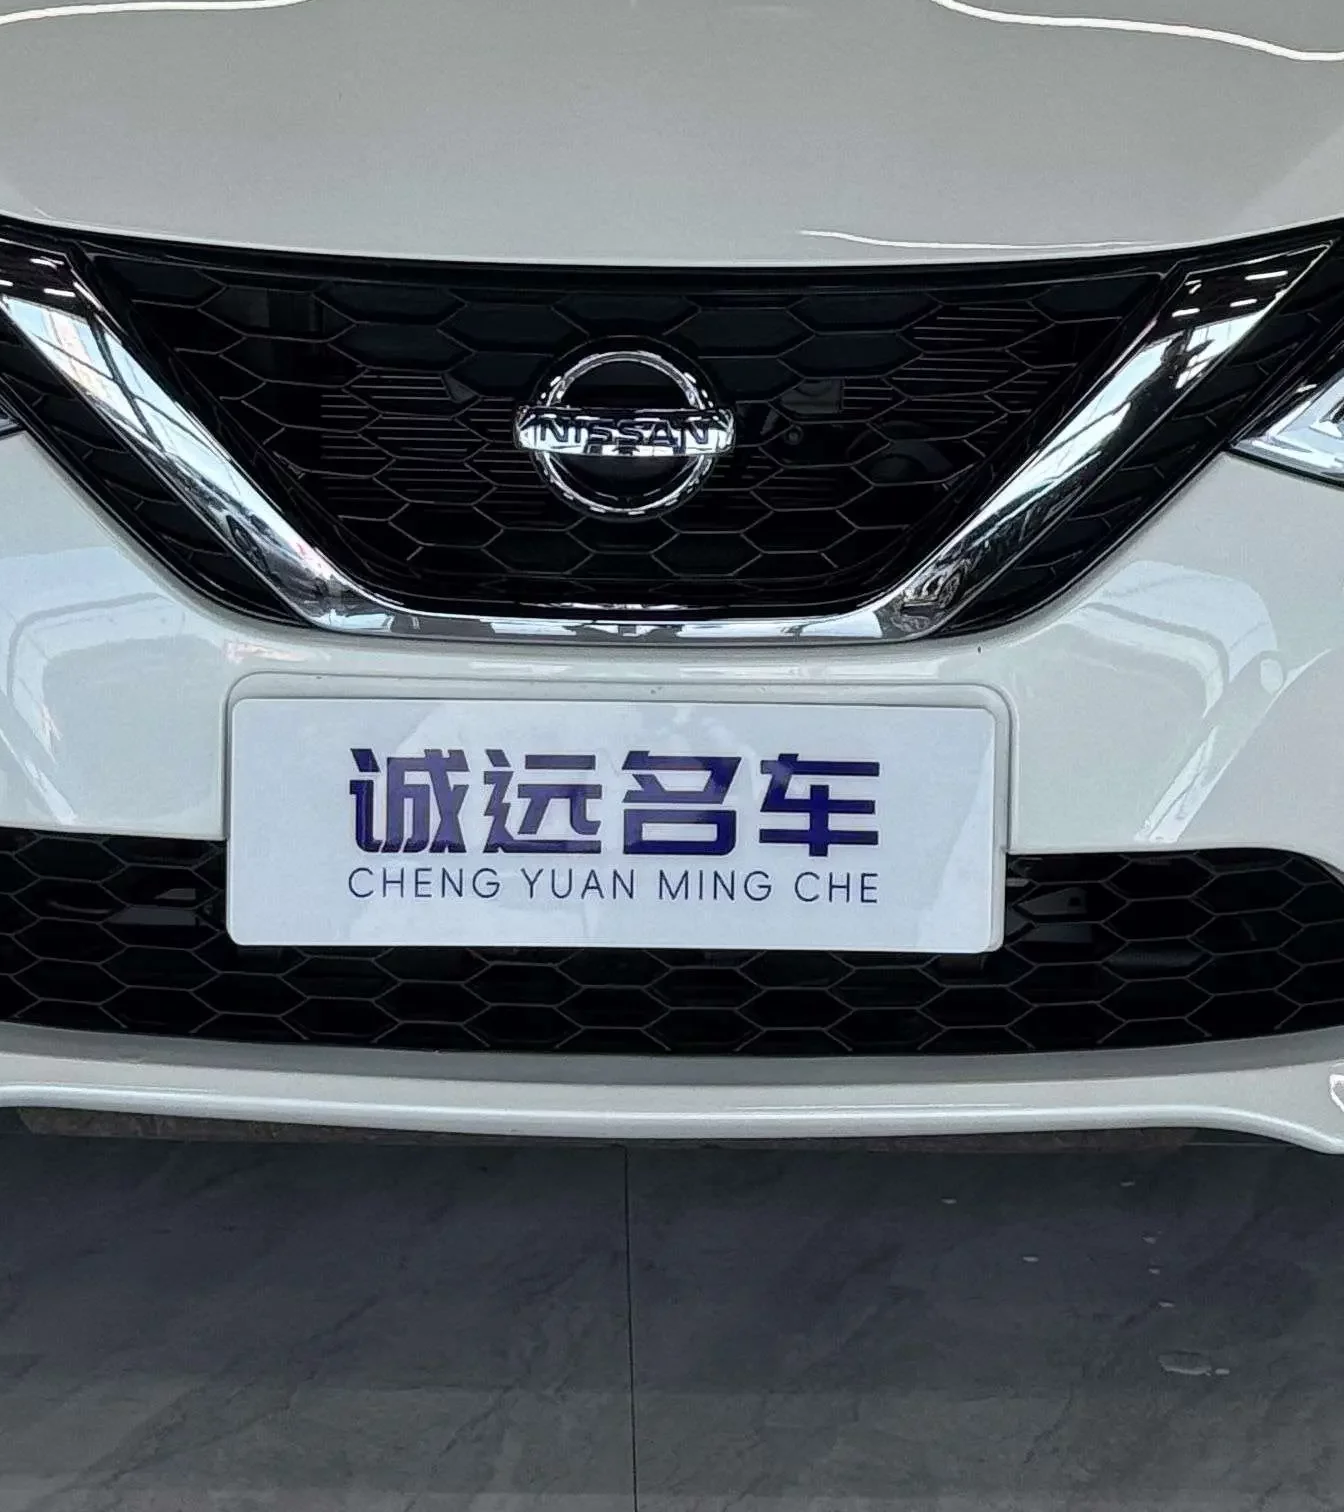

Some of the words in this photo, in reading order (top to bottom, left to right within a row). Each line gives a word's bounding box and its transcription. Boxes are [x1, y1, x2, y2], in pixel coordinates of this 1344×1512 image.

[540, 416, 709, 447] NISSAN
[348, 747, 881, 858] 诚远名车
[348, 867, 501, 899] CHENG
[520, 868, 635, 900] YUAN
[658, 869, 772, 902] MING
[794, 871, 879, 904] CHE
